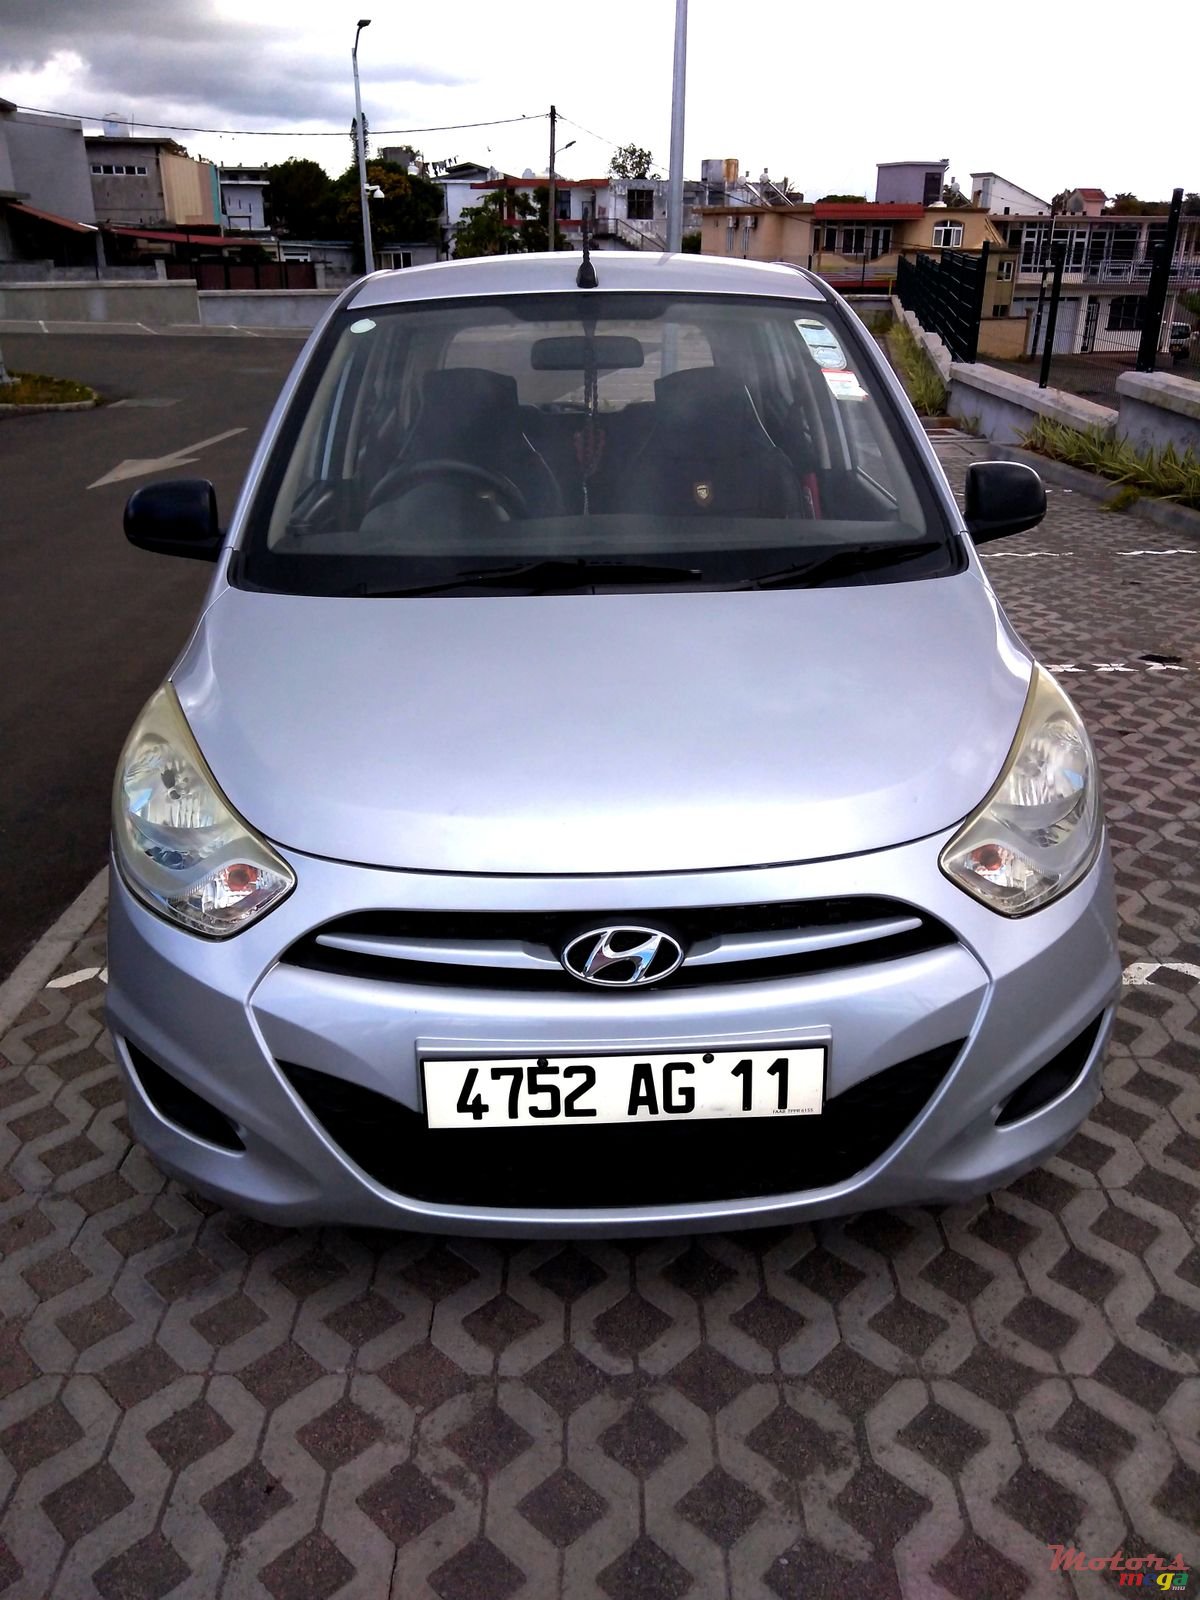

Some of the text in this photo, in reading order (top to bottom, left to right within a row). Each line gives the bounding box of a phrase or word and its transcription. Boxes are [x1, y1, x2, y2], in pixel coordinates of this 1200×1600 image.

[457, 1058, 788, 1120] 4752 AG 11
